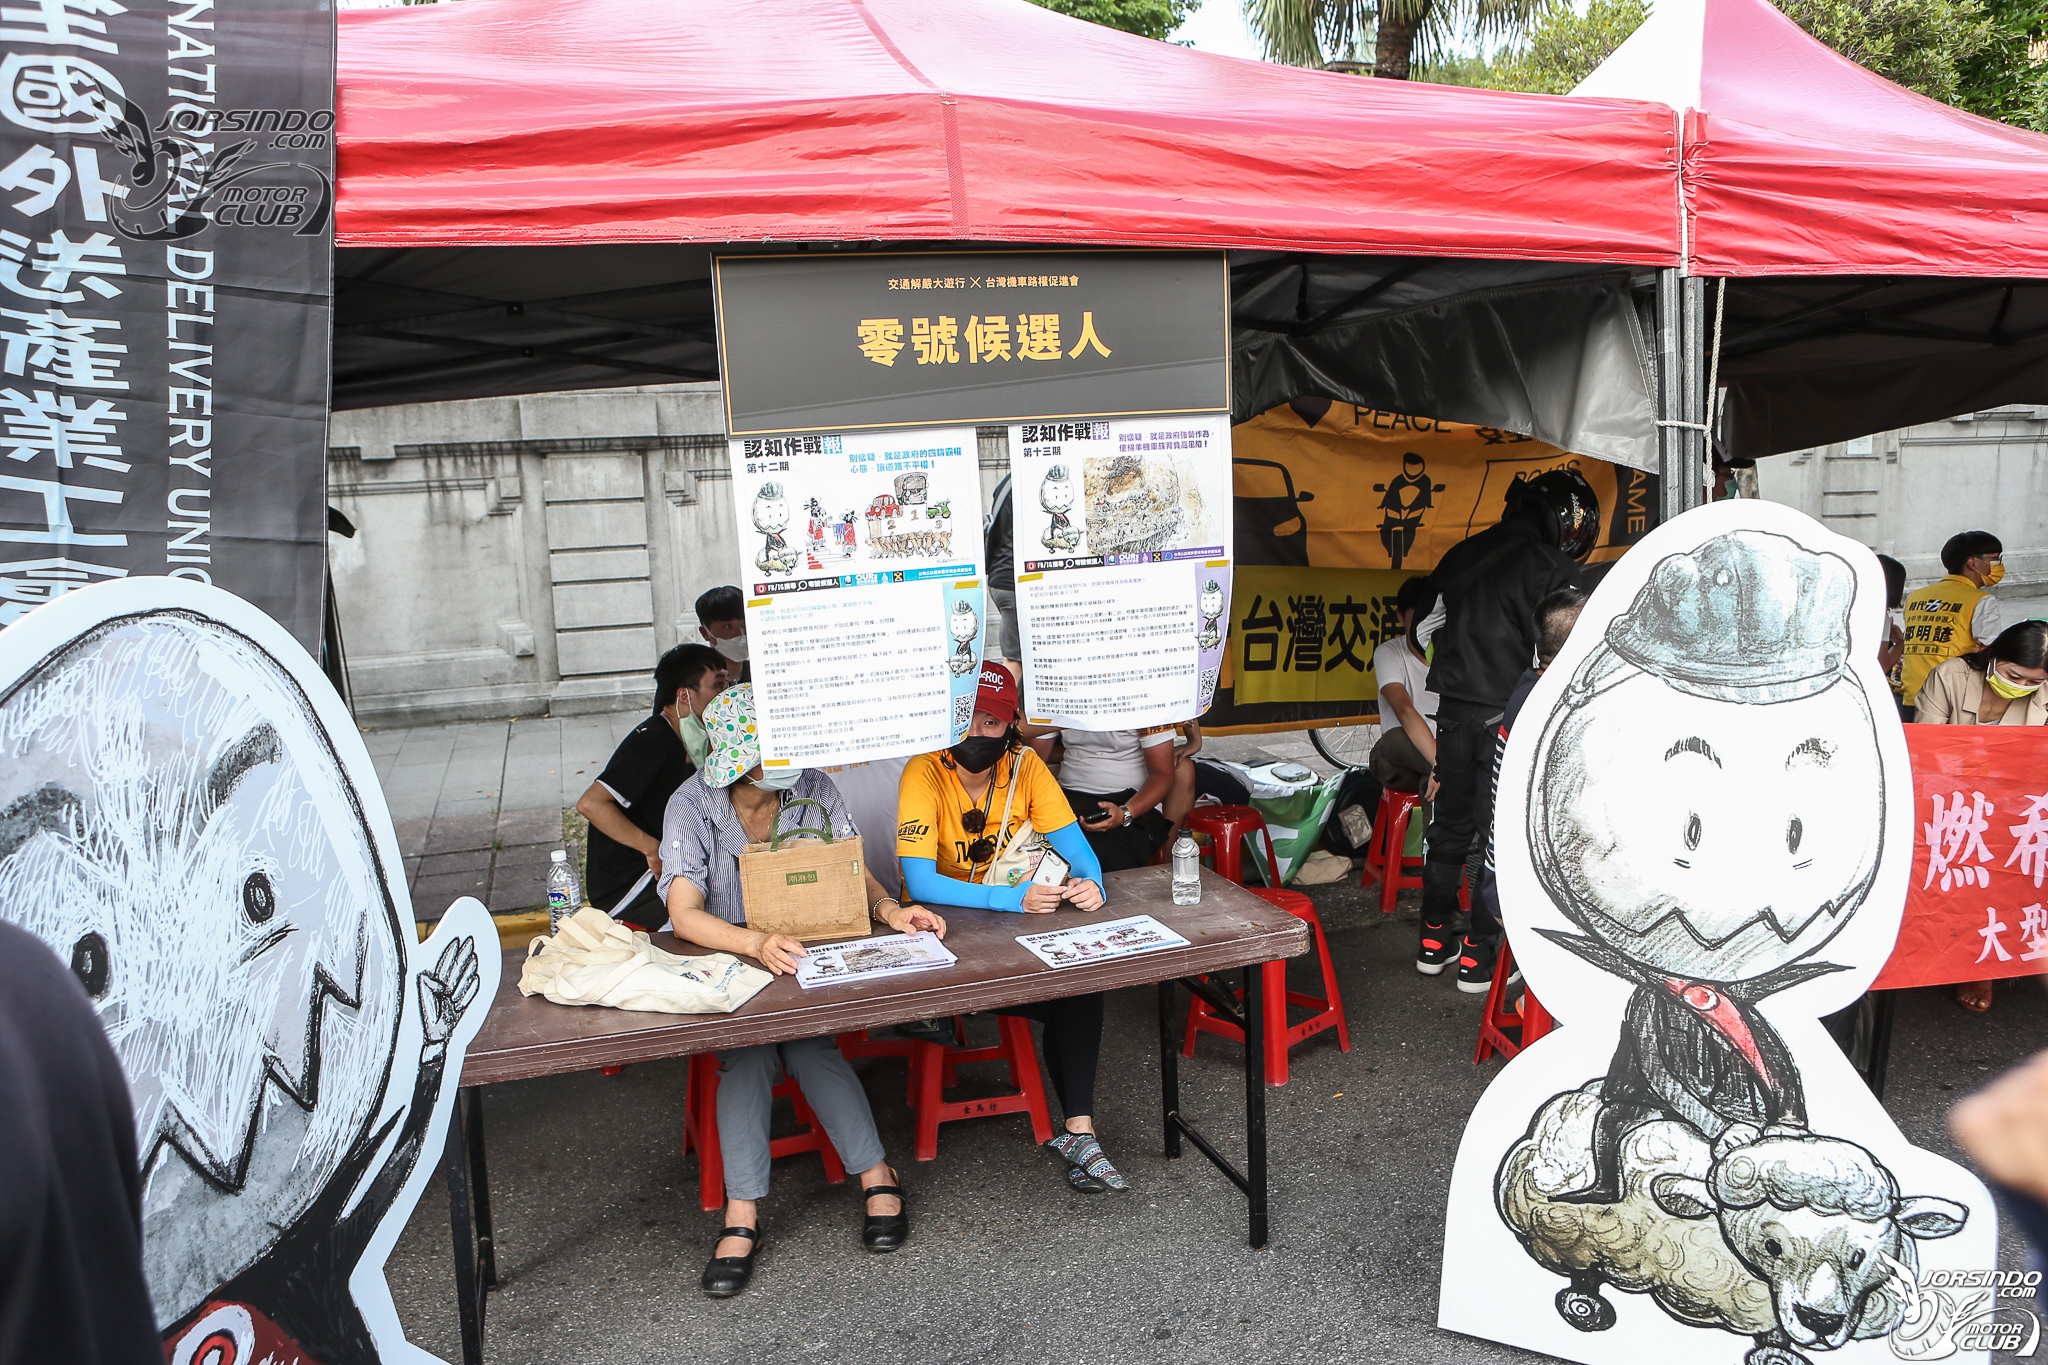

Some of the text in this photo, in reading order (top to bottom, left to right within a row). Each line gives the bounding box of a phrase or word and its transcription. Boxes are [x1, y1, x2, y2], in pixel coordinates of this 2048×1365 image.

[888, 277, 966, 291] 交通解嚴大遊行
[985, 274, 1080, 289] 台灣機車路權促進會
[857, 311, 1112, 367] 零號候選人
[165, 244, 216, 478] DELIVERY
[1022, 421, 1110, 443] 認知作戰報
[744, 435, 842, 459] 認知作戰報
[1023, 446, 1062, 458] 第十三期
[746, 461, 790, 474] 第十二期
[911, 509, 919, 521] 1
[887, 520, 897, 530] 2
[935, 519, 943, 529] 3
